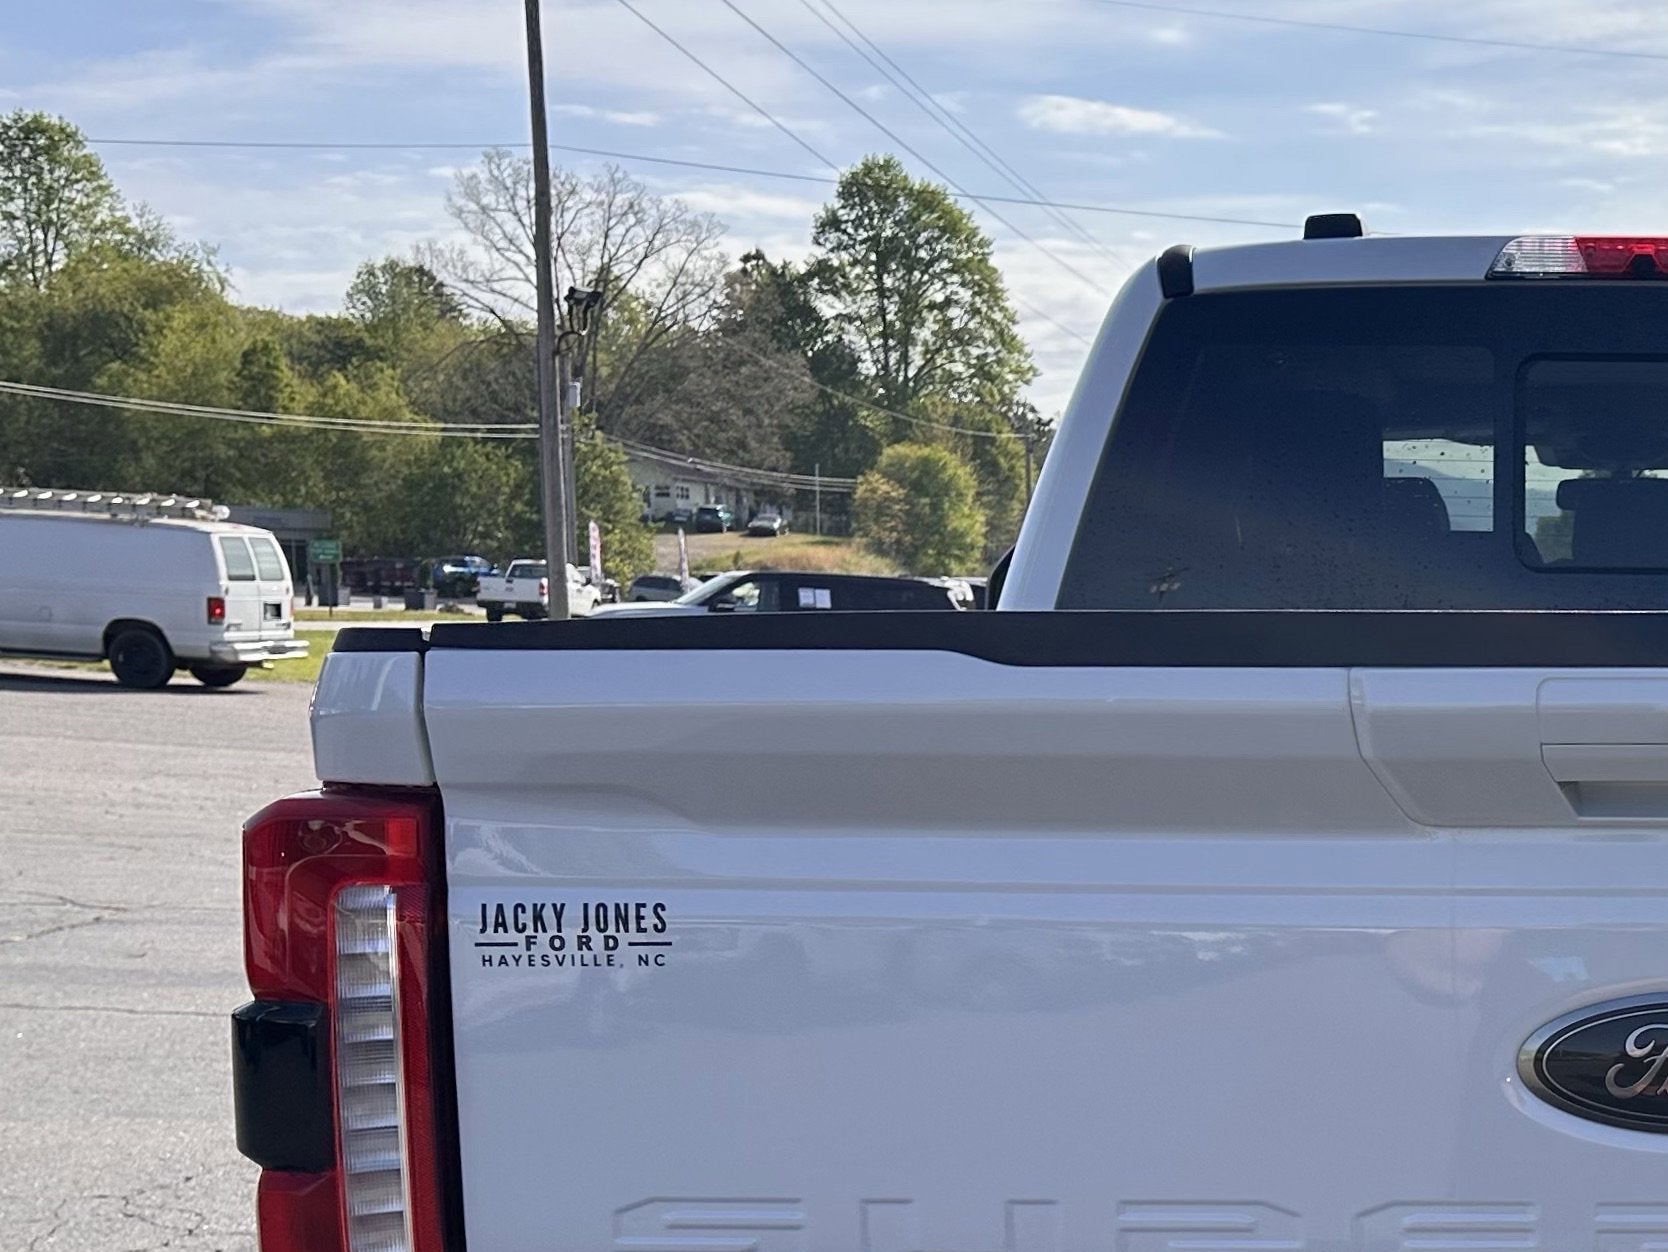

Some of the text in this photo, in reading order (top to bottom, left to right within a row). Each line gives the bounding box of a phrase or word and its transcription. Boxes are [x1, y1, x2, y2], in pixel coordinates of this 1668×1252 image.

[479, 902, 667, 934] JACKY JONES
[525, 935, 620, 951] FORD
[482, 954, 666, 968] HAYESVILLE, NC
